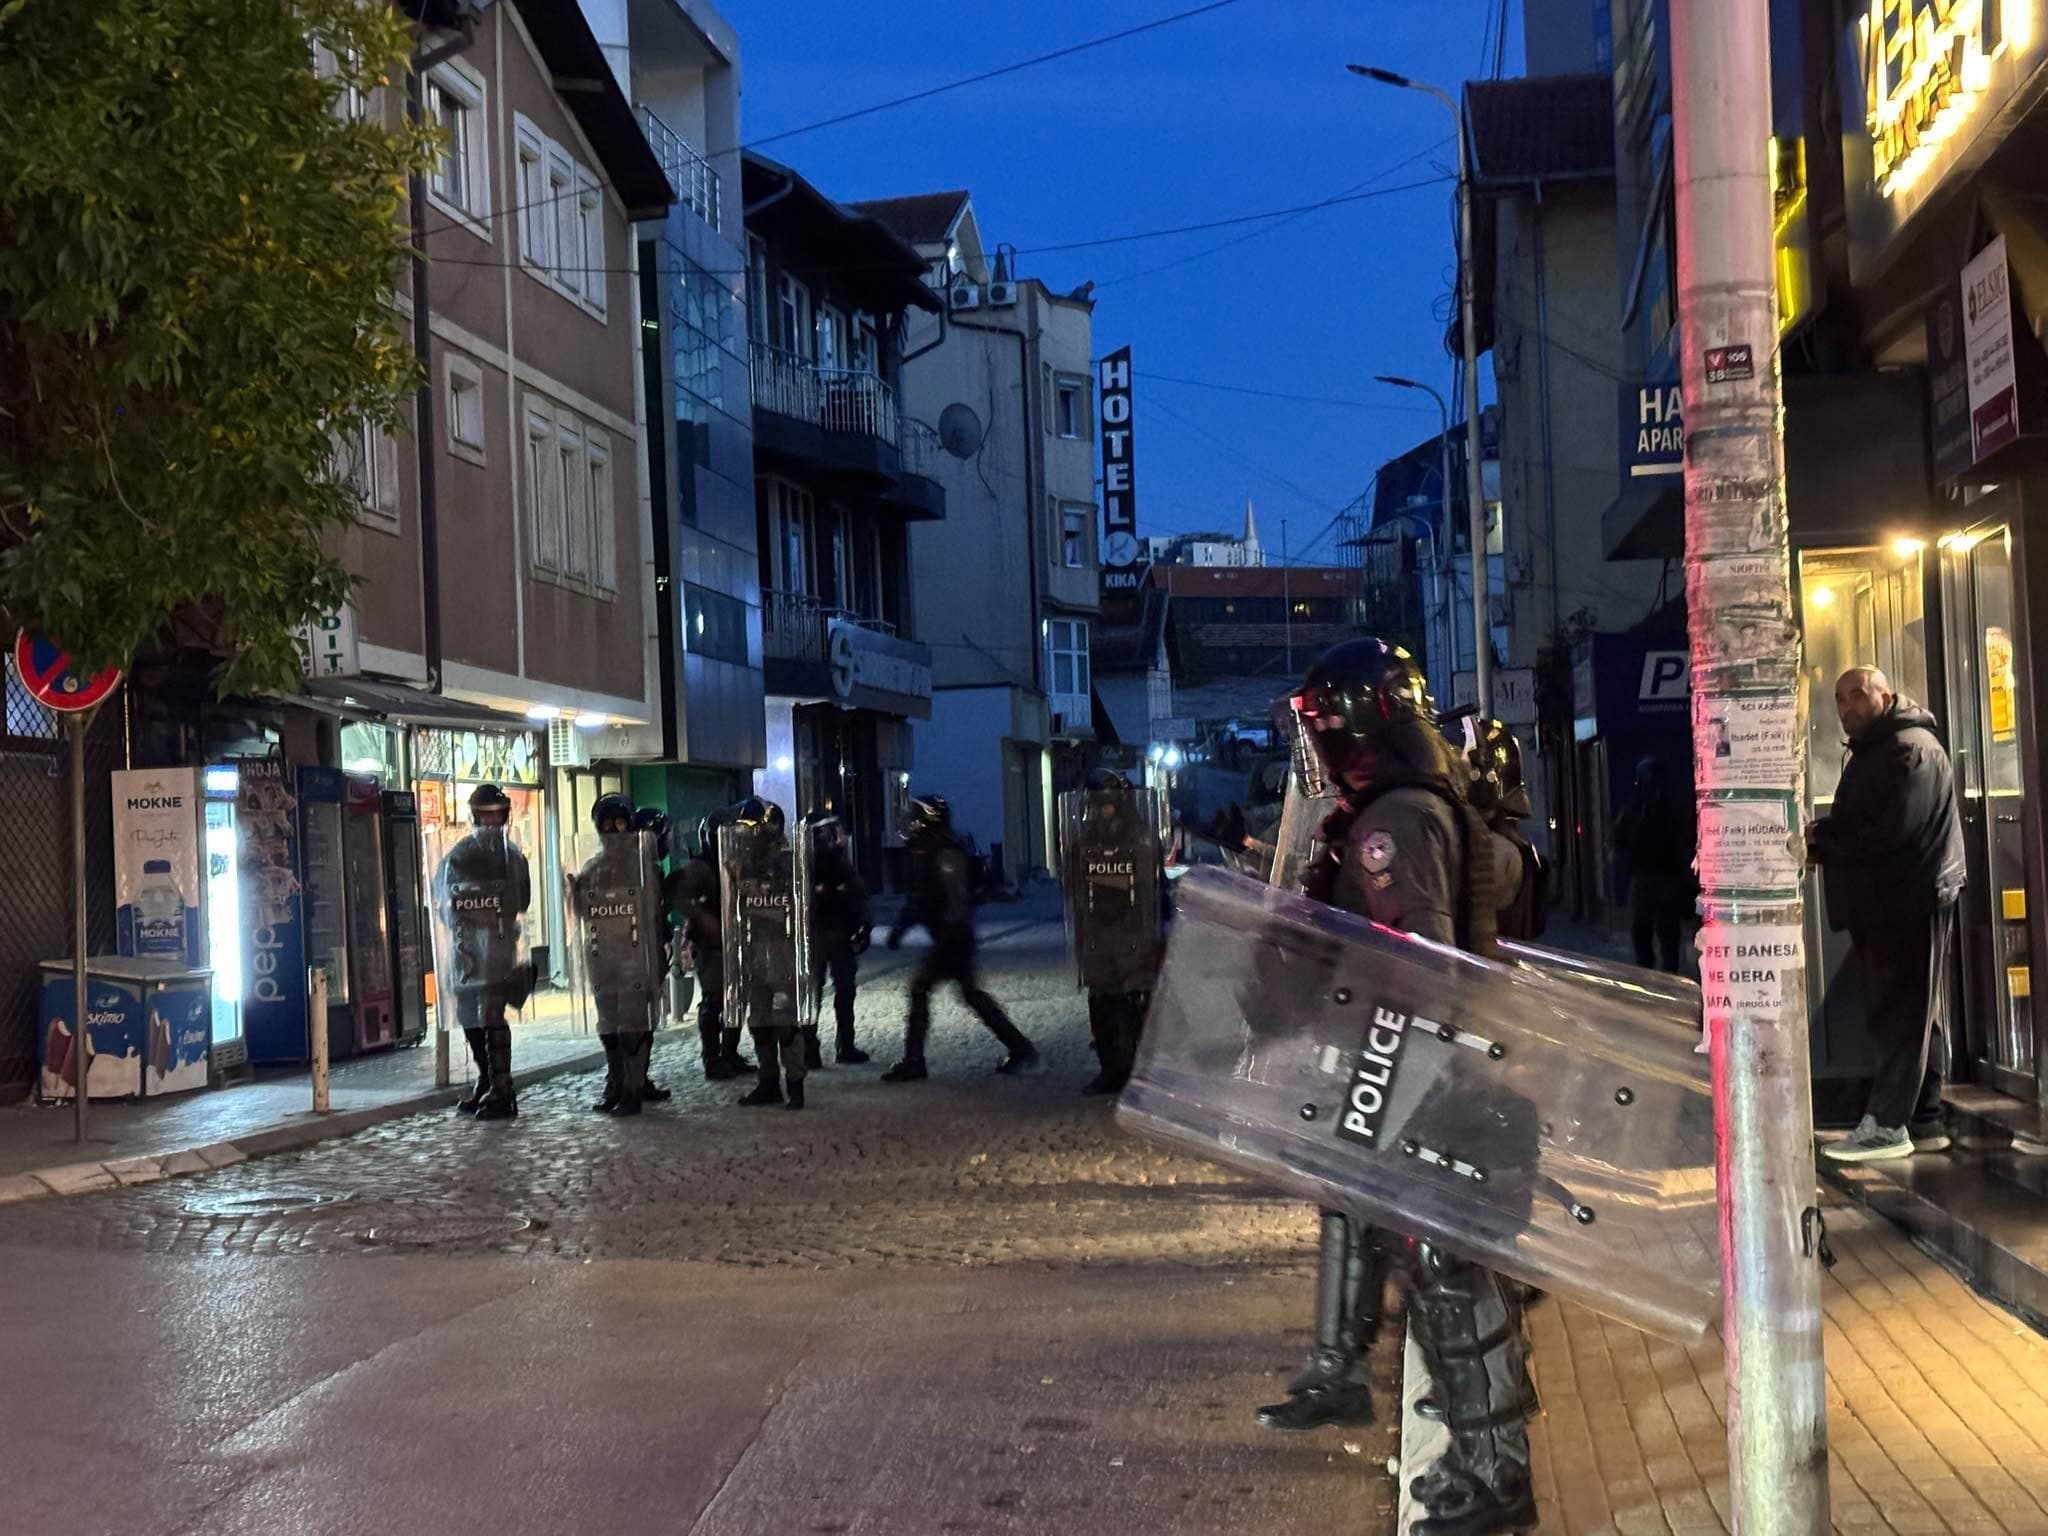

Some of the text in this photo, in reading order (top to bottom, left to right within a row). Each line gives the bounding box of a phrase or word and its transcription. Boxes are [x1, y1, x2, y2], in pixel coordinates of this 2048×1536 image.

[1640, 387, 1684, 423] HA
[1102, 360, 1130, 524] HOTEL
[1105, 573, 1136, 588] KIKA
[1650, 656, 1685, 696] P
[128, 797, 182, 810] MOKNE
[1088, 863, 1134, 874] POLICE
[455, 897, 500, 911] POLICE
[745, 895, 790, 907] POLICE
[590, 903, 635, 917] POLICE
[140, 928, 179, 939] MOKNE
[1736, 944, 1799, 957] BANESA
[253, 926, 286, 1002] pep
[1344, 1006, 1406, 1137] POLICE
